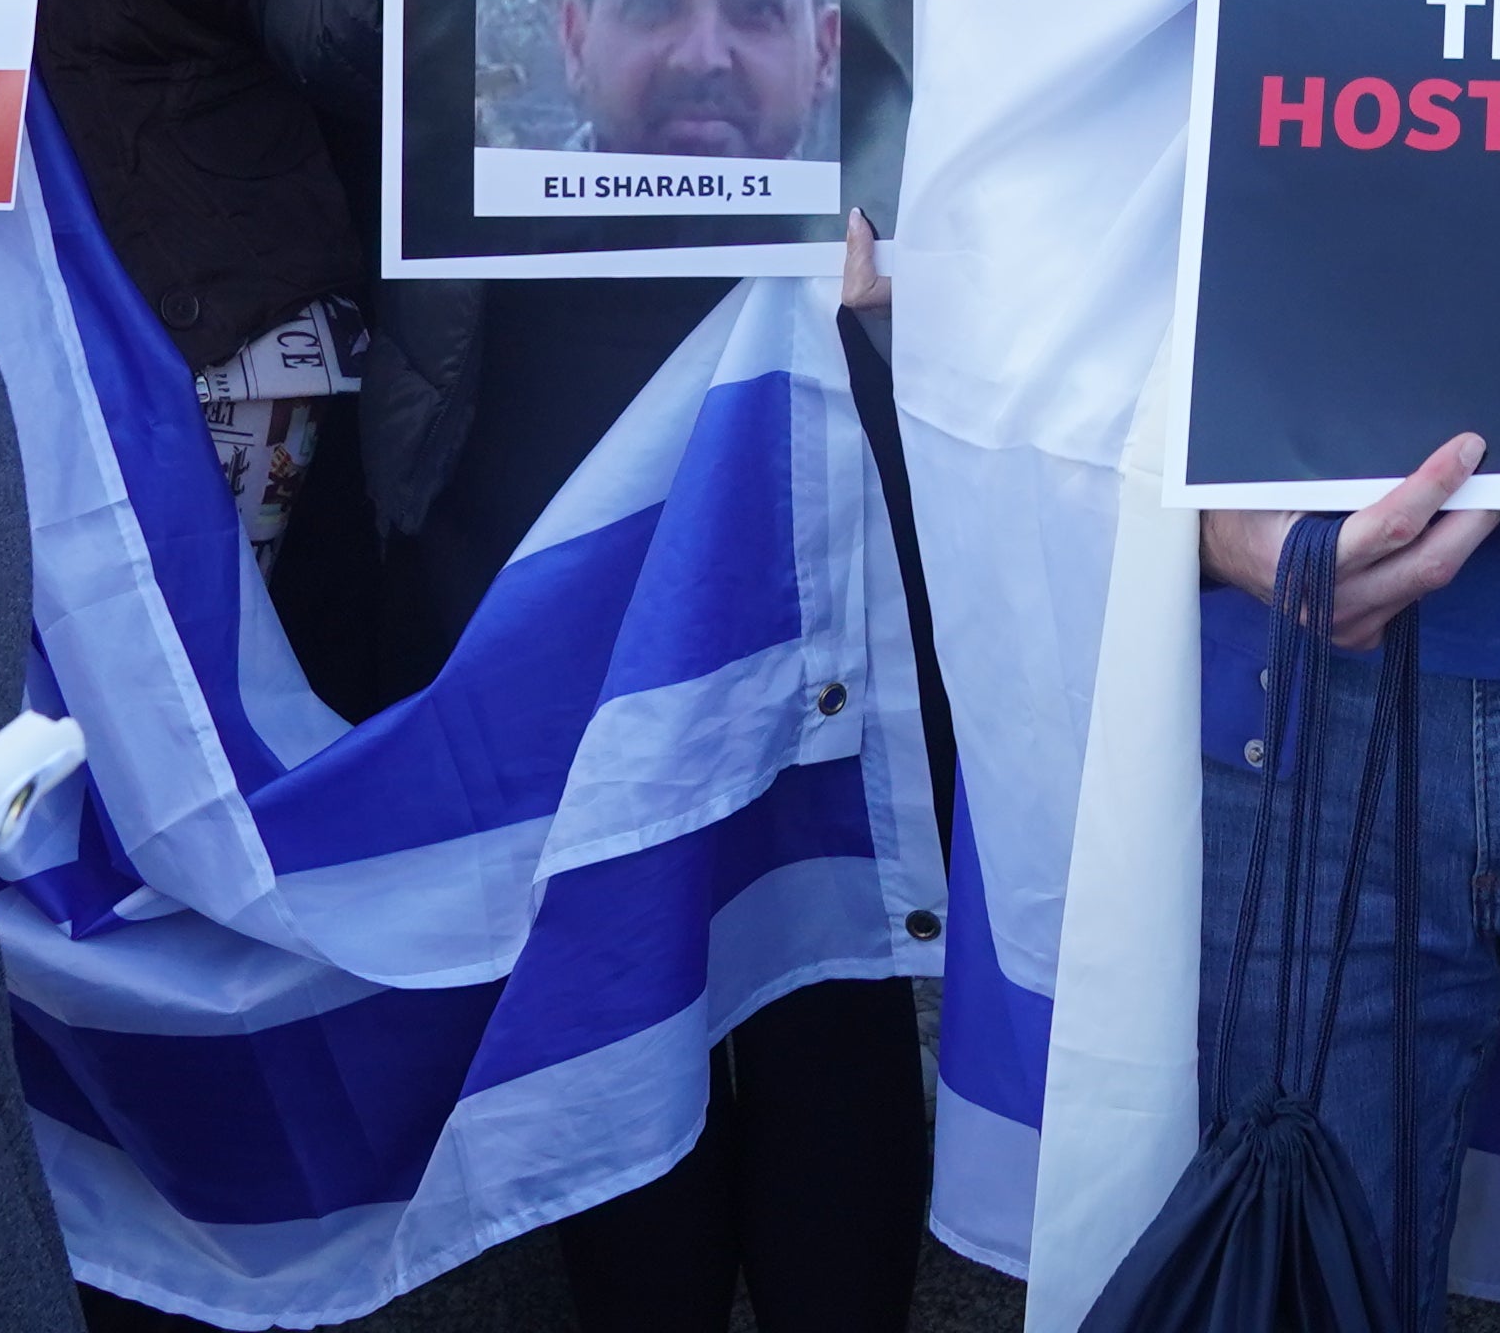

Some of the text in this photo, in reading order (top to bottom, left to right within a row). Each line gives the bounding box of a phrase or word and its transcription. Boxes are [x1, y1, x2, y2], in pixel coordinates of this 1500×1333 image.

[545, 175, 771, 201] ELI SHARABI, 51
